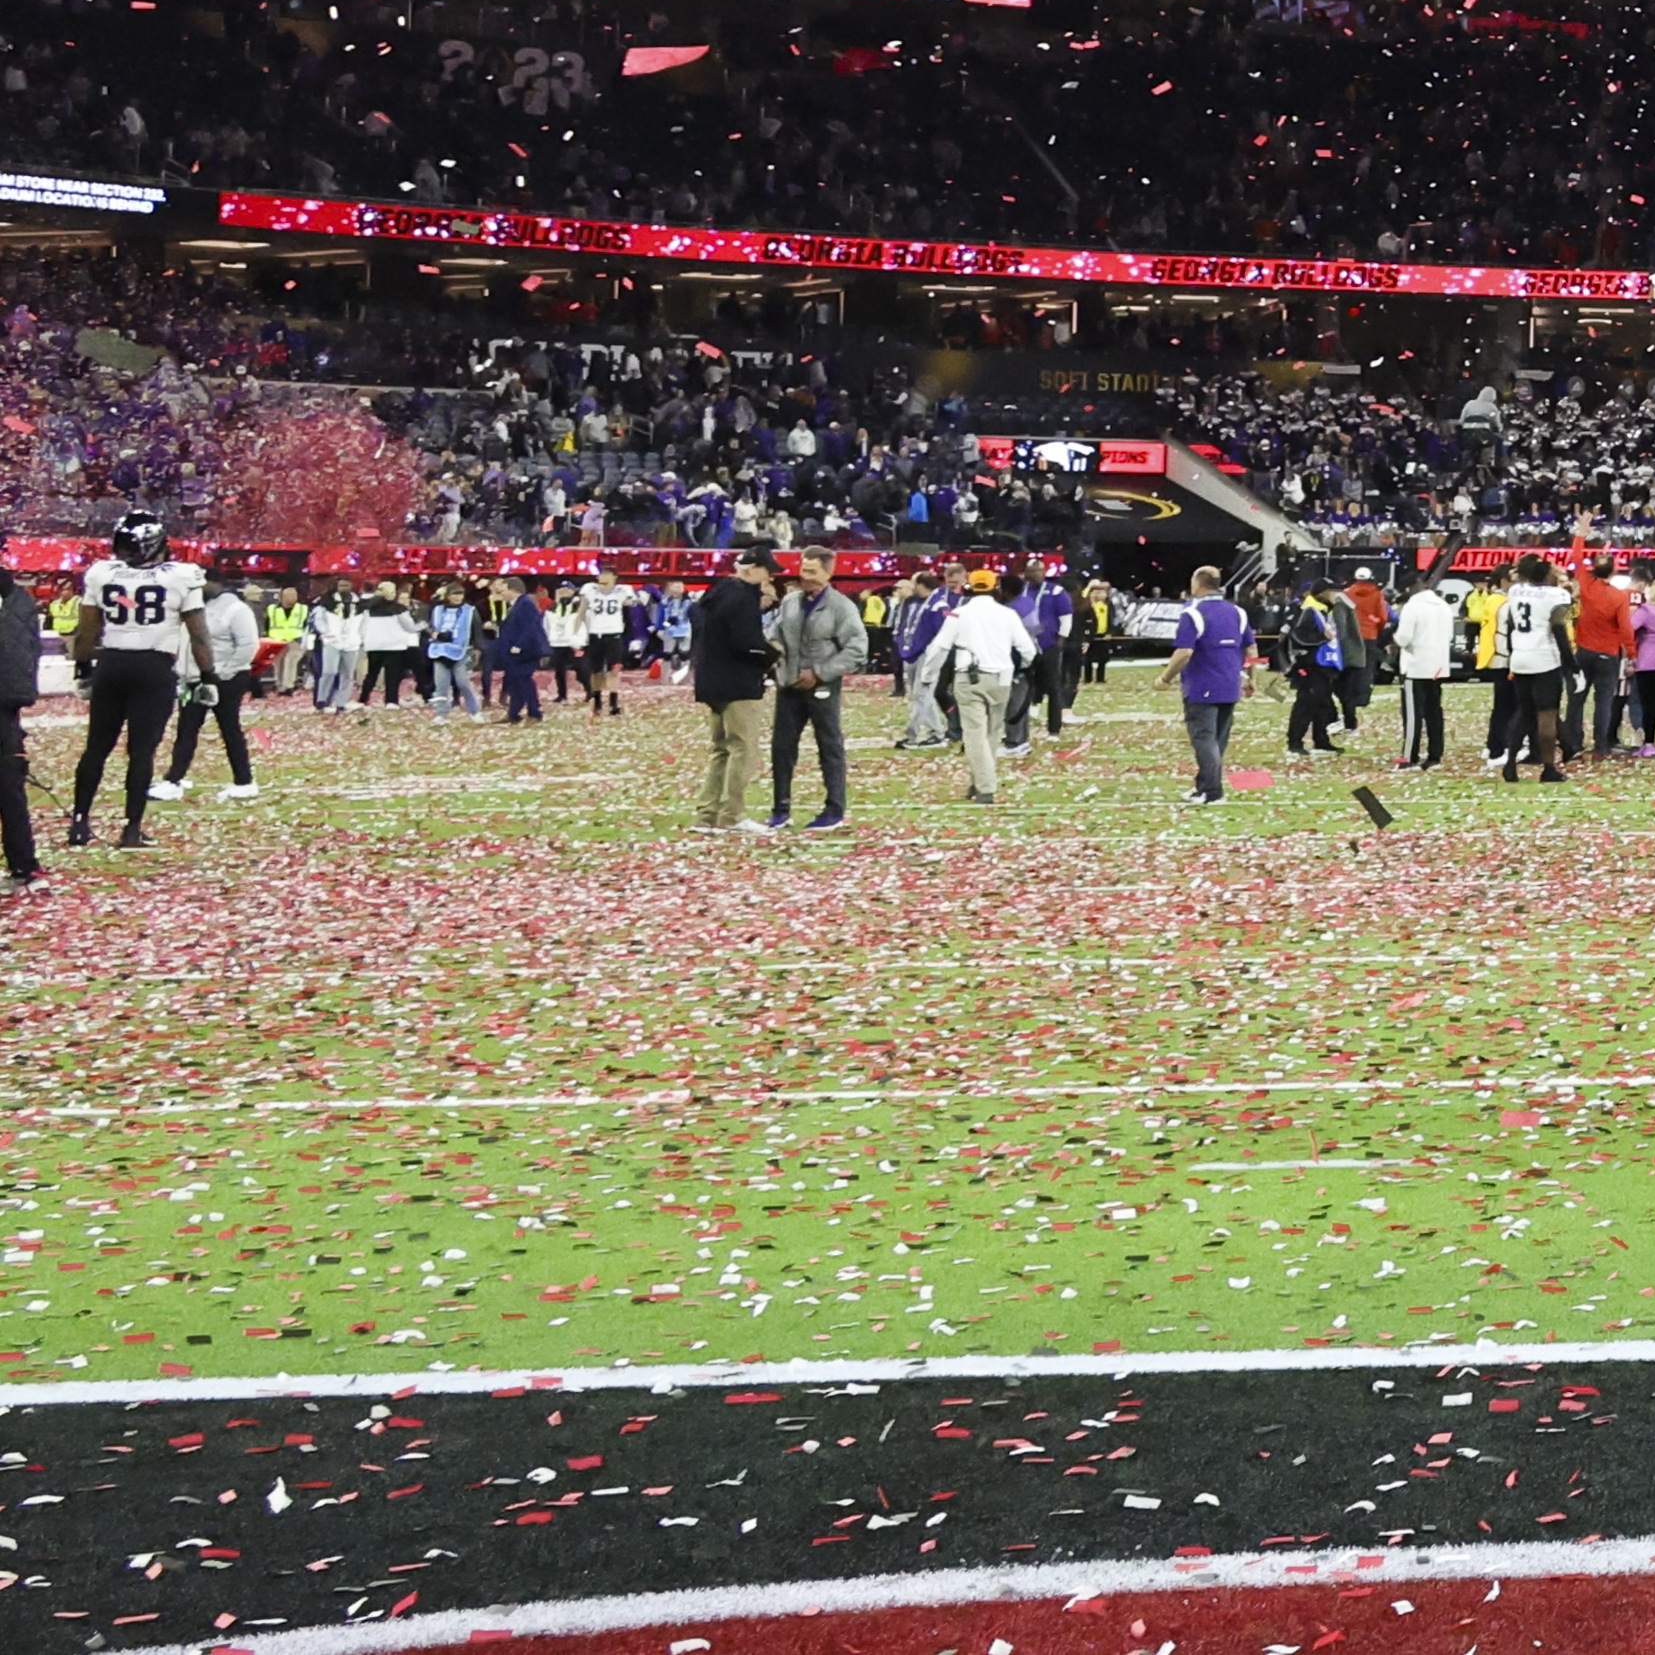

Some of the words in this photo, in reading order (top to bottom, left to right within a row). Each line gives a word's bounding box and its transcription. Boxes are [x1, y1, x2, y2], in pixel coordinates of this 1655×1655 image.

[763, 237, 884, 263] GEORGIA
[891, 244, 1024, 272] BULLDOGS
[1151, 258, 1264, 282] GEORGIA
[1271, 264, 1401, 289] BULLDOGS
[1458, 550, 1529, 567] ATION
[103, 583, 167, 625] 98
[593, 598, 619, 615] 36
[1517, 602, 1531, 633] 3
